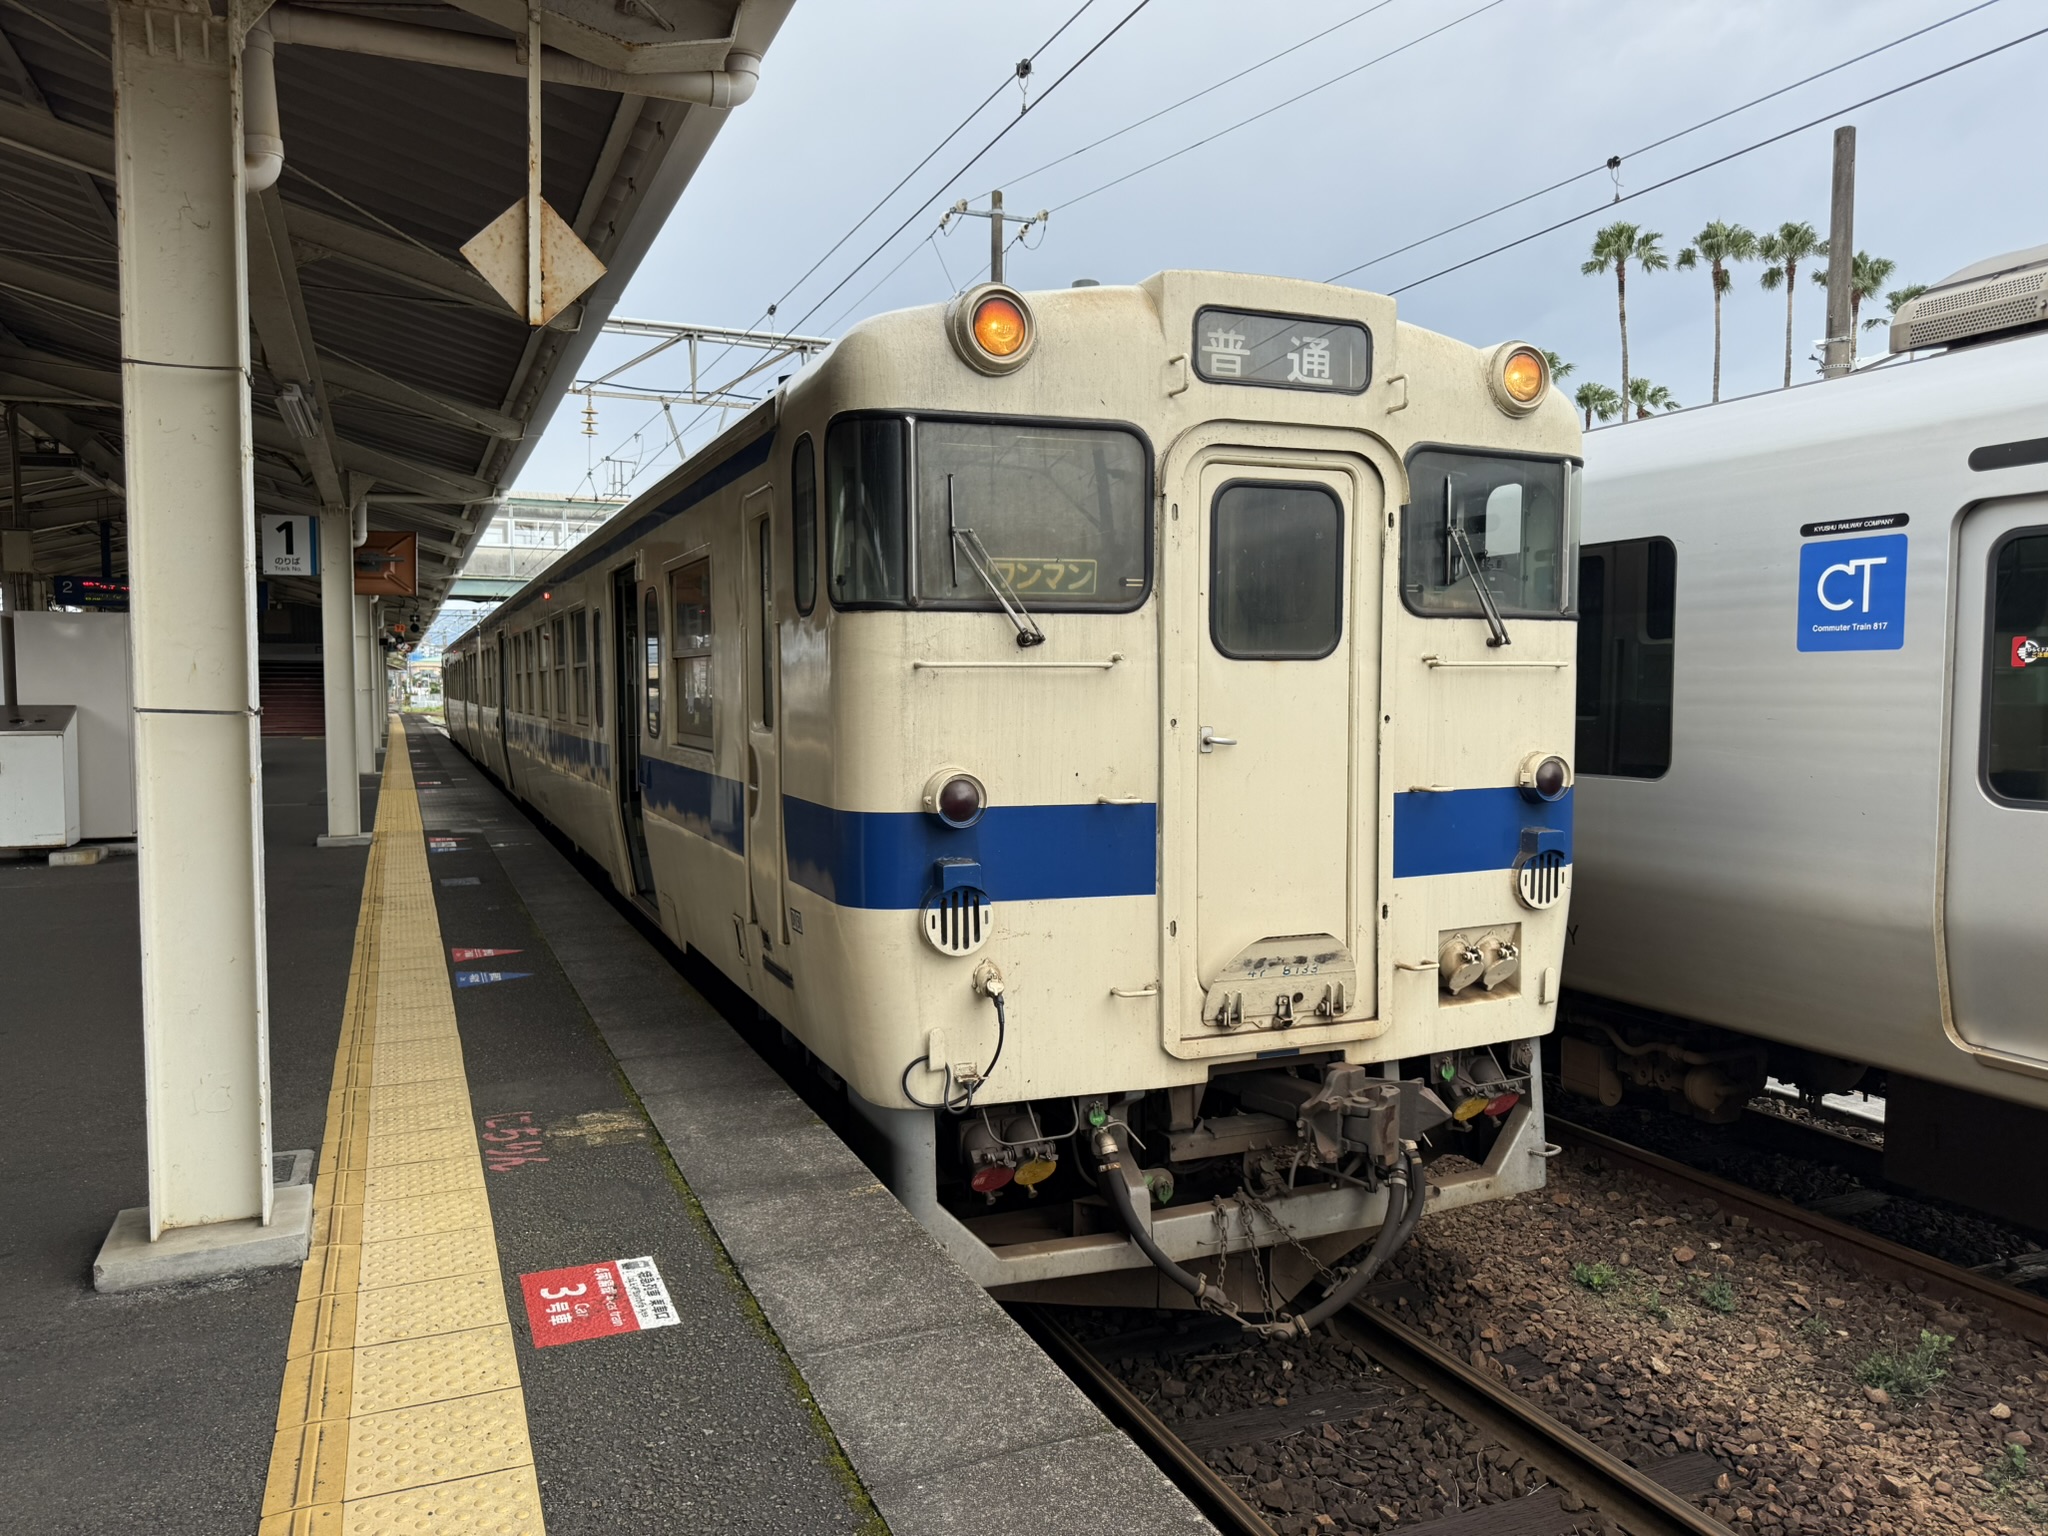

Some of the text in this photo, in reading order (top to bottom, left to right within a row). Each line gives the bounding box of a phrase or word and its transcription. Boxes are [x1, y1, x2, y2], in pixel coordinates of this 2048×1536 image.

[1201, 328, 1334, 386] 普通
[1813, 518, 1894, 533] KYUSHU RAILWAY COMPANY
[275, 521, 294, 555] 1
[274, 557, 301, 565] のりば
[989, 562, 1093, 590] ワンマン
[1817, 556, 1887, 613] CT
[62, 580, 73, 594] 2
[1812, 622, 1888, 632] Commuter Train 817
